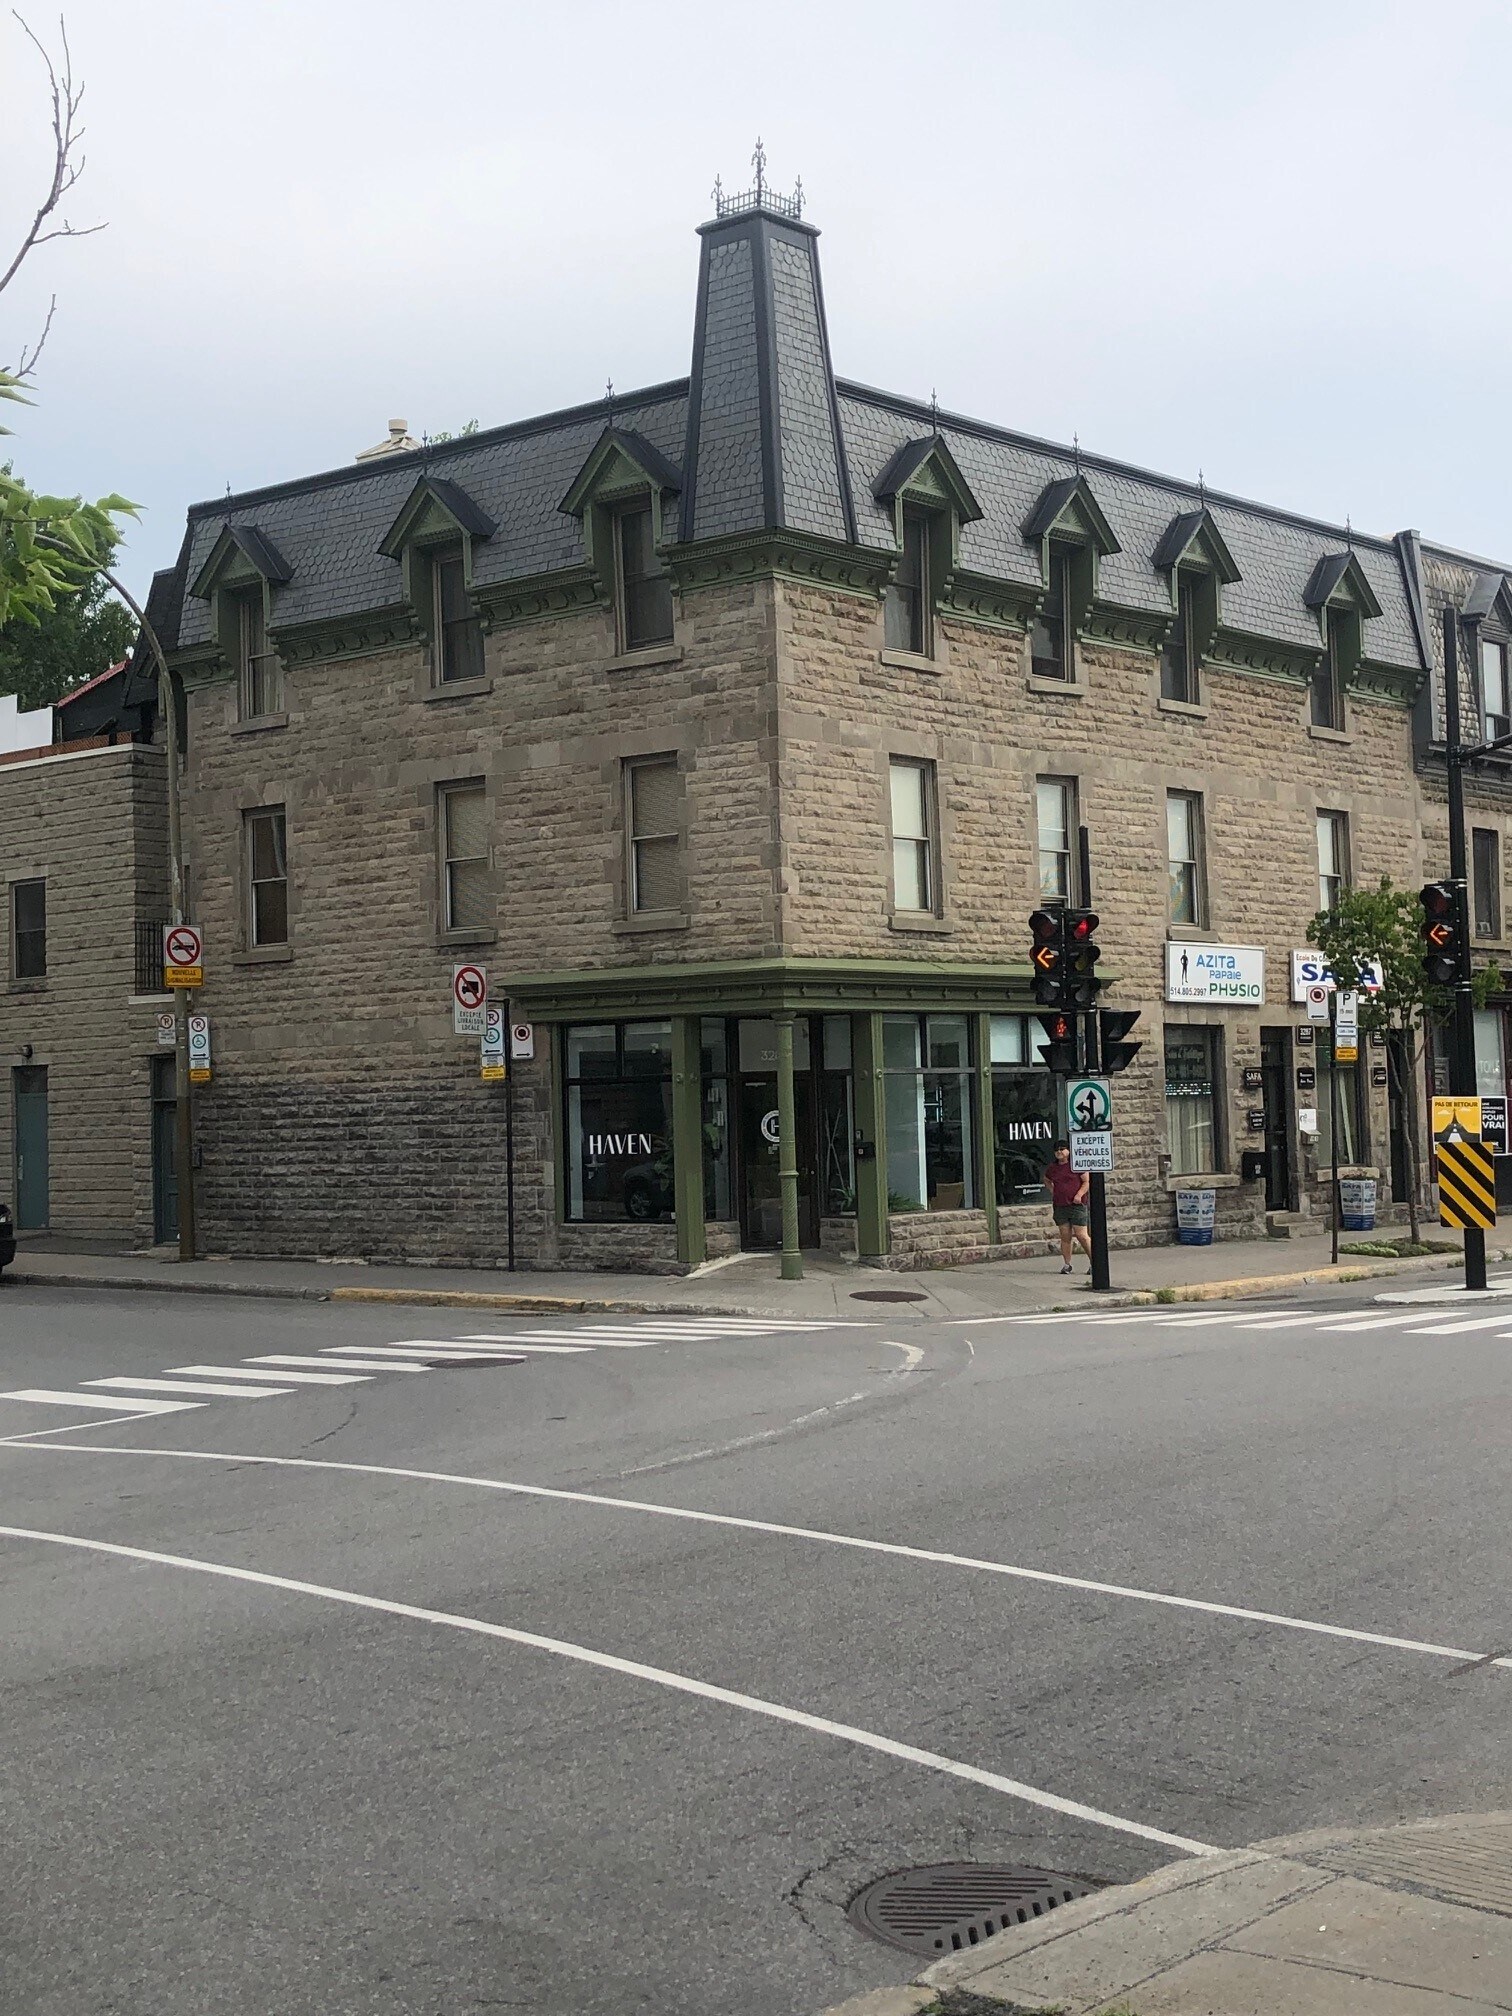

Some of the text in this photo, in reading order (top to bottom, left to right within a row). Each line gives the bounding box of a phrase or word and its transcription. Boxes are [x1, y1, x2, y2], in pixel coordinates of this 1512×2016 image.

[1302, 963, 1378, 985] SAA
[1246, 1072, 1262, 1081] SAFA
[1482, 1121, 1505, 1129] VRAI
[1009, 1122, 1052, 1141] HAVEN
[589, 1133, 652, 1155] HAVEN
[1074, 1146, 1110, 1156] VÉHICULES
[1075, 1157, 1111, 1168] AUTORISÉS
